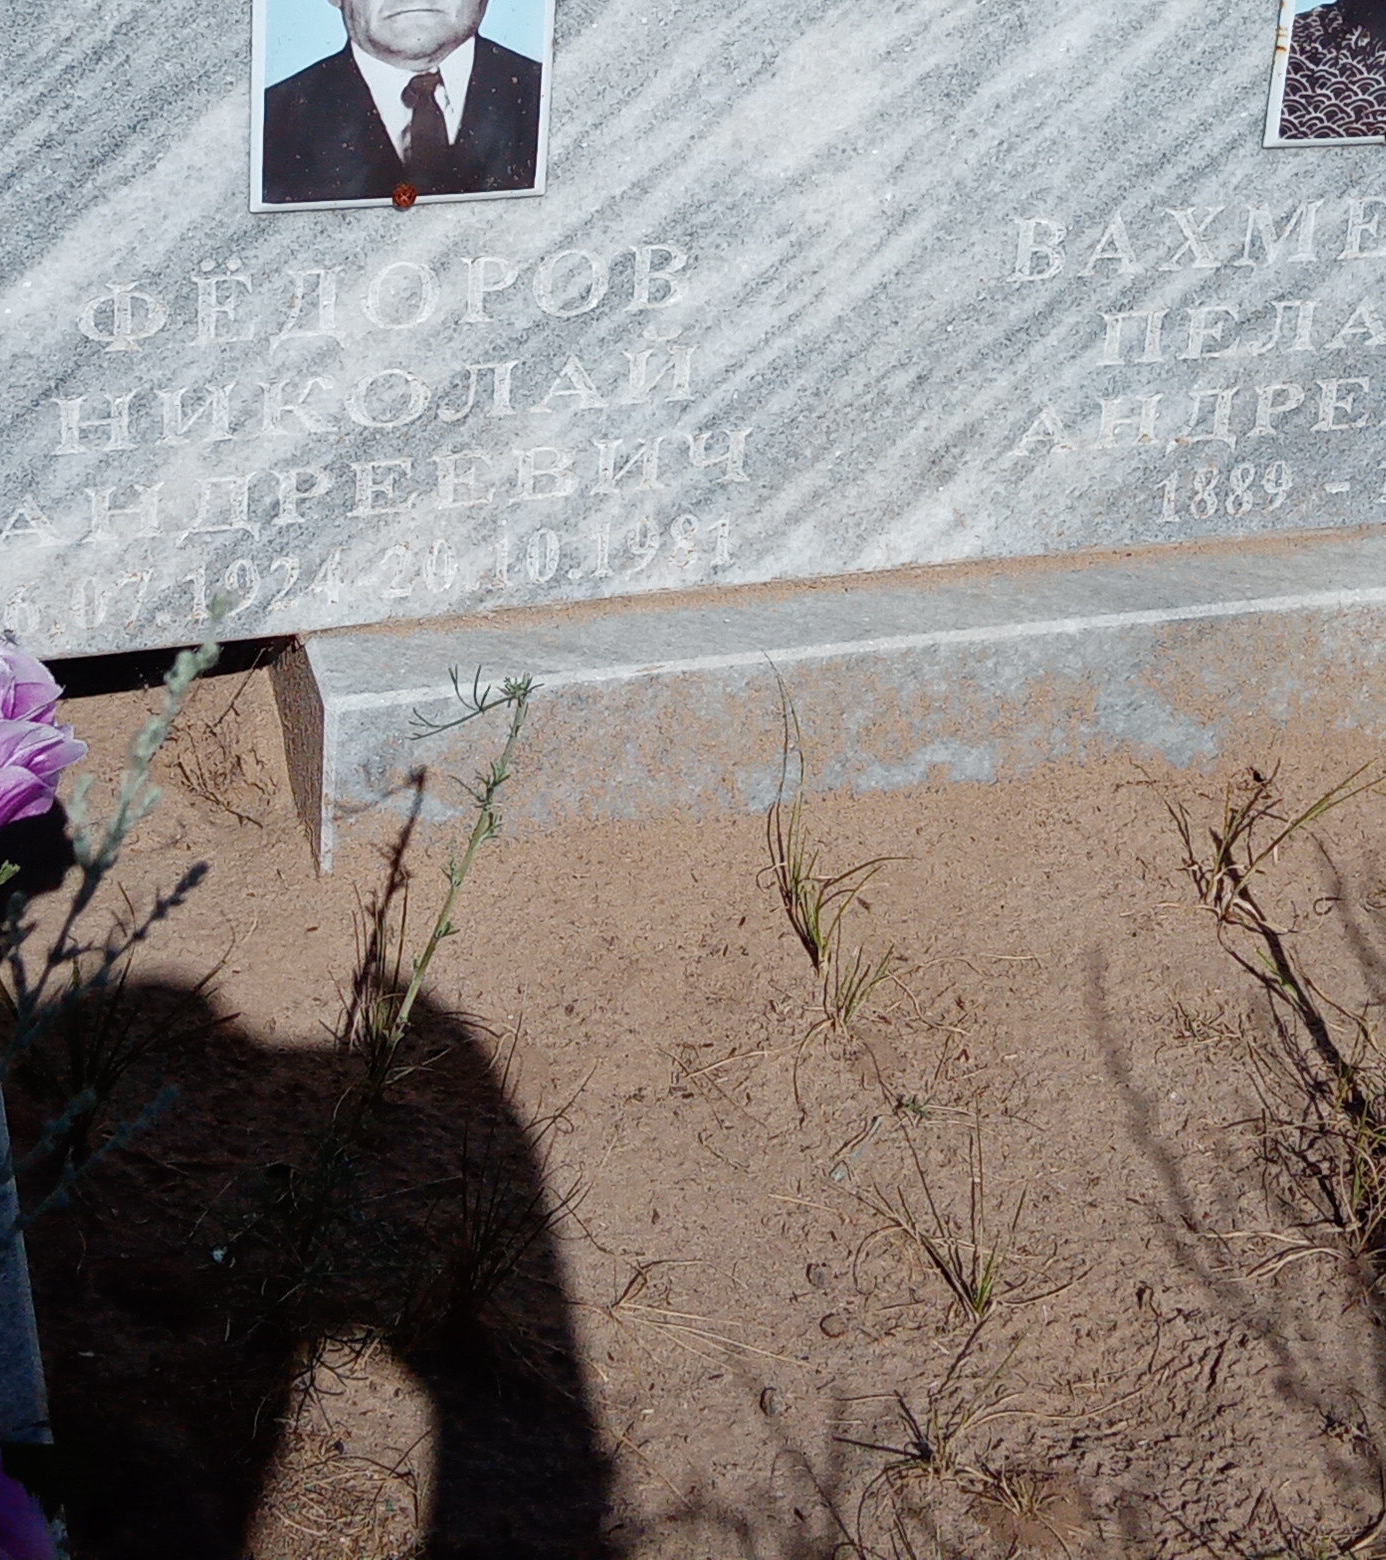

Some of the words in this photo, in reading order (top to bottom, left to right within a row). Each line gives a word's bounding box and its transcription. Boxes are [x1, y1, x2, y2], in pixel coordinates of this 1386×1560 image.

[76, 241, 690, 352] ФЁДОРОВ
[52, 325, 701, 455] НИКОЛАЙ
[1155, 460, 1293, 523] 1889
